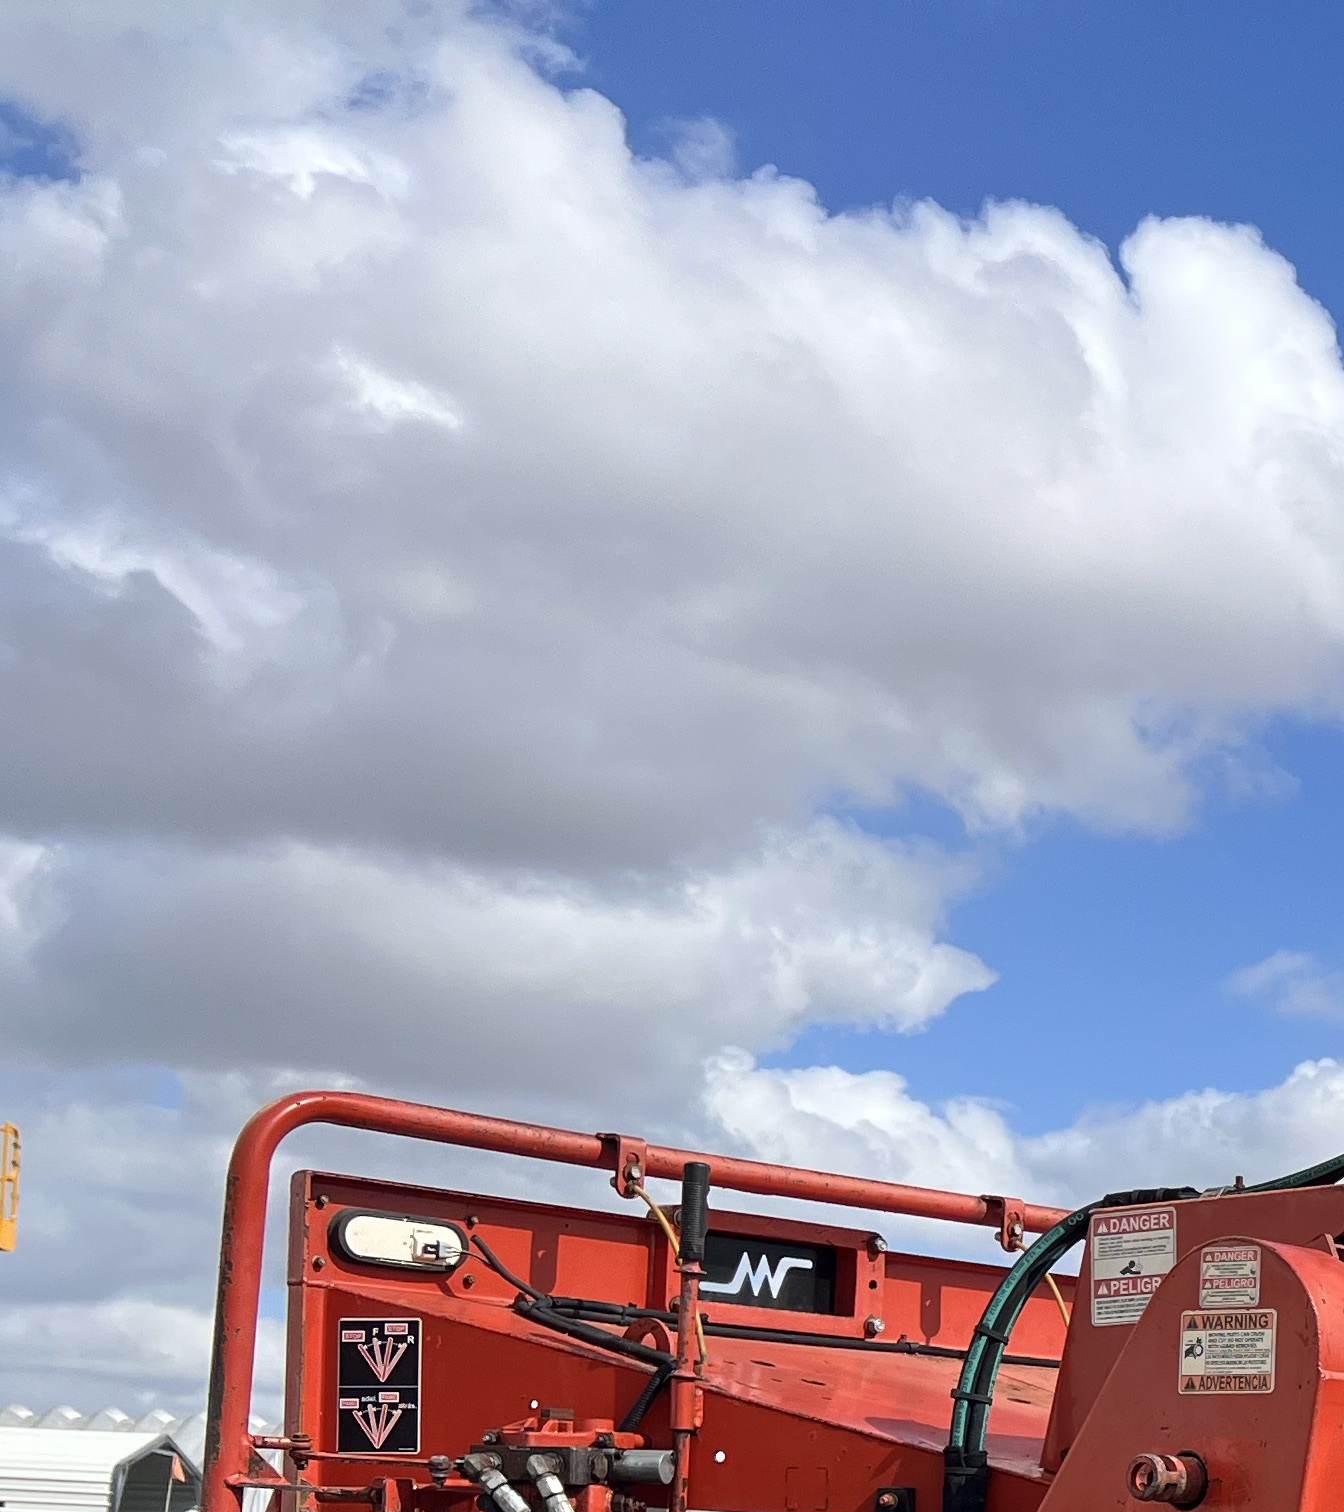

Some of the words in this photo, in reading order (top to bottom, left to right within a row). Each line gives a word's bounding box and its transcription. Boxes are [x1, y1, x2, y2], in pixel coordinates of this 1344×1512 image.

[1110, 1214, 1170, 1233] DANGER
[1214, 1251, 1254, 1261] DANGER
[1110, 1277, 1162, 1295] PELIGR
[1213, 1279, 1254, 1288] PELIGRO
[1202, 1314, 1268, 1329] WARNING
[407, 1336, 414, 1344] R
[1199, 1375, 1268, 1390] ADVERTENCIA
